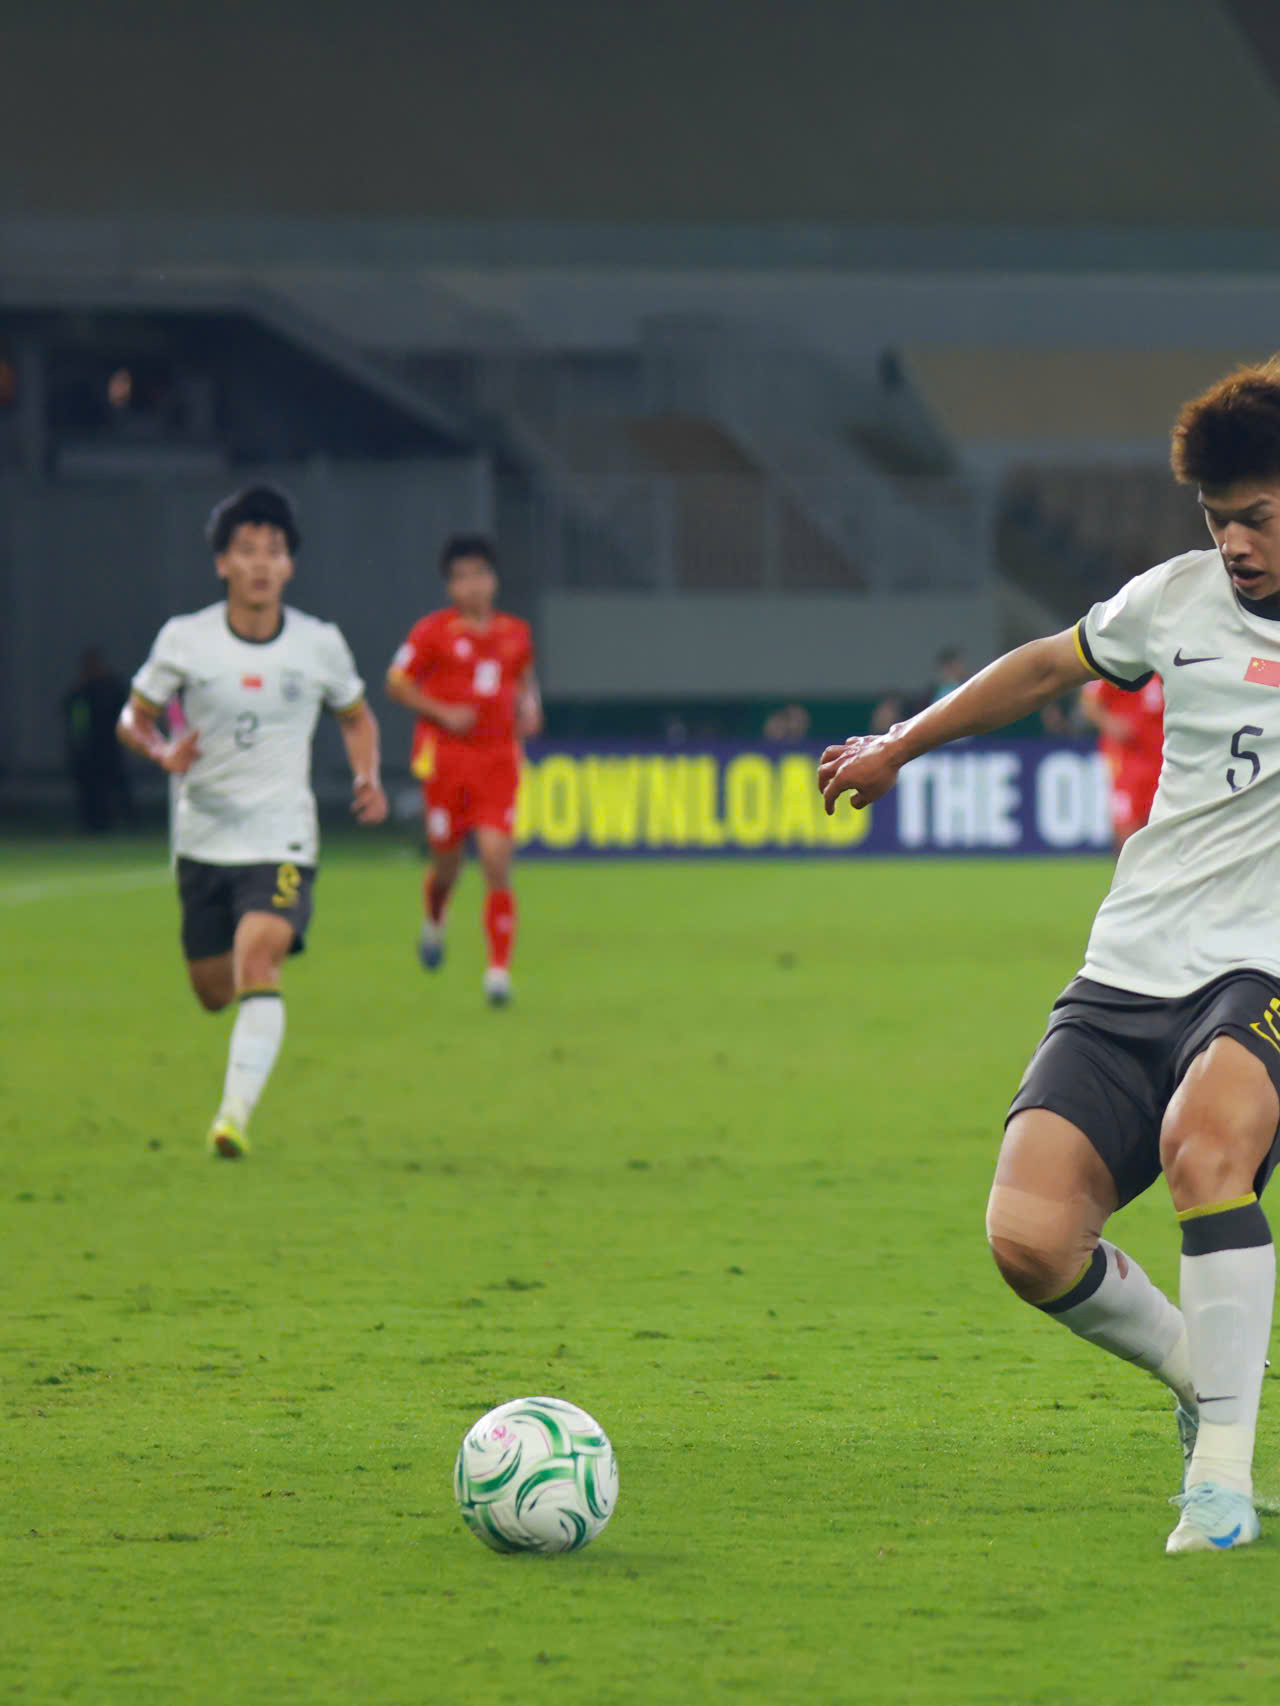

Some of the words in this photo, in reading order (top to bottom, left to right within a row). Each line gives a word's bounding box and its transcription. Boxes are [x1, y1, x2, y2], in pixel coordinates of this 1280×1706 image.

[234, 711, 260, 752] 2
[1226, 725, 1264, 793] 5
[897, 752, 1023, 849] THE
